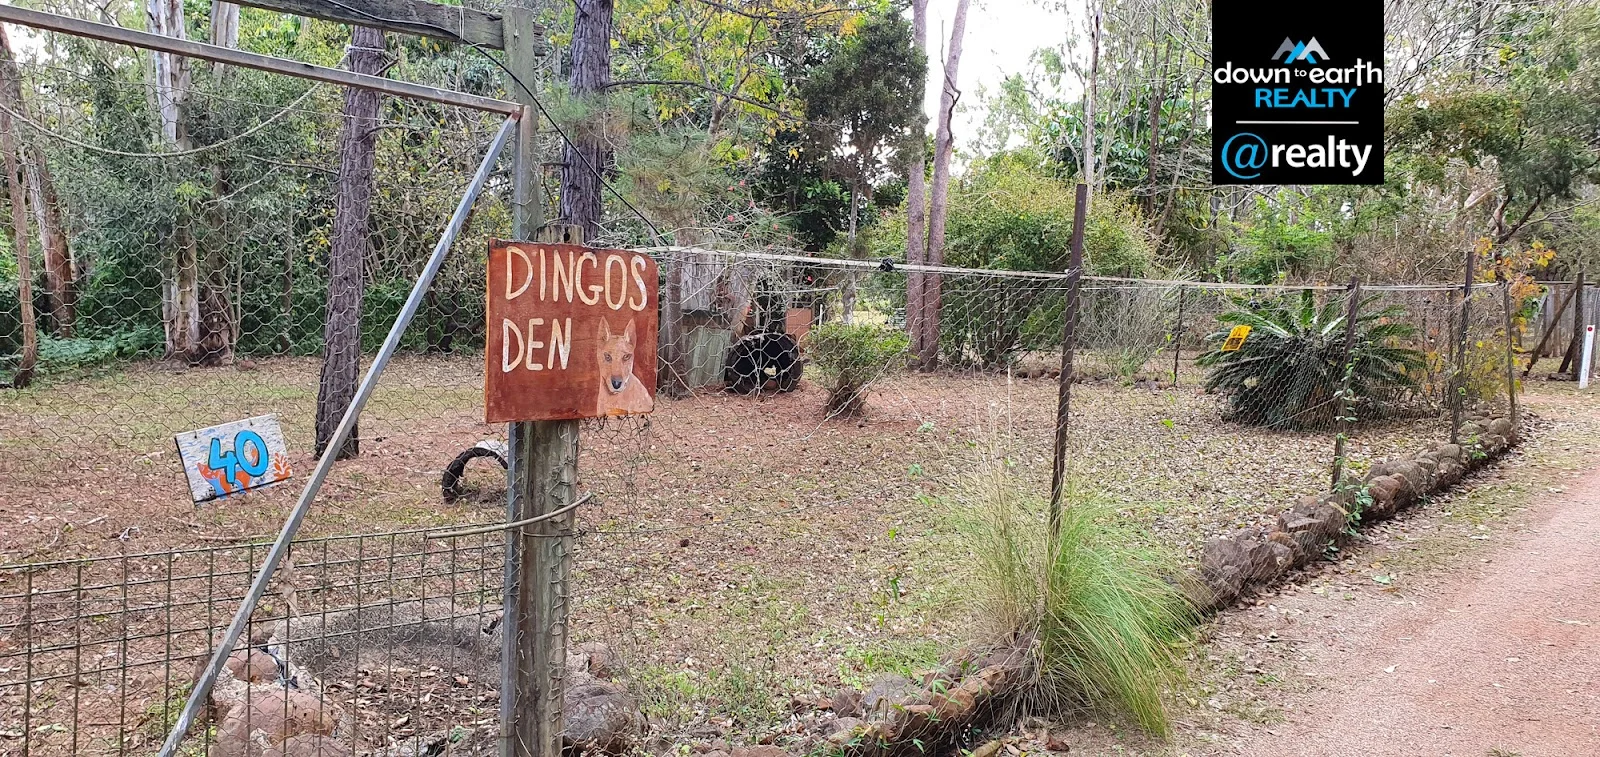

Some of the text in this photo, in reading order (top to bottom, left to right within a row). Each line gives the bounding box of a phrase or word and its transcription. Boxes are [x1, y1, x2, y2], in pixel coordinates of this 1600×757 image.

[505, 246, 648, 312] DINGOS
[502, 317, 572, 373] DEN
[208, 430, 269, 484] 40
